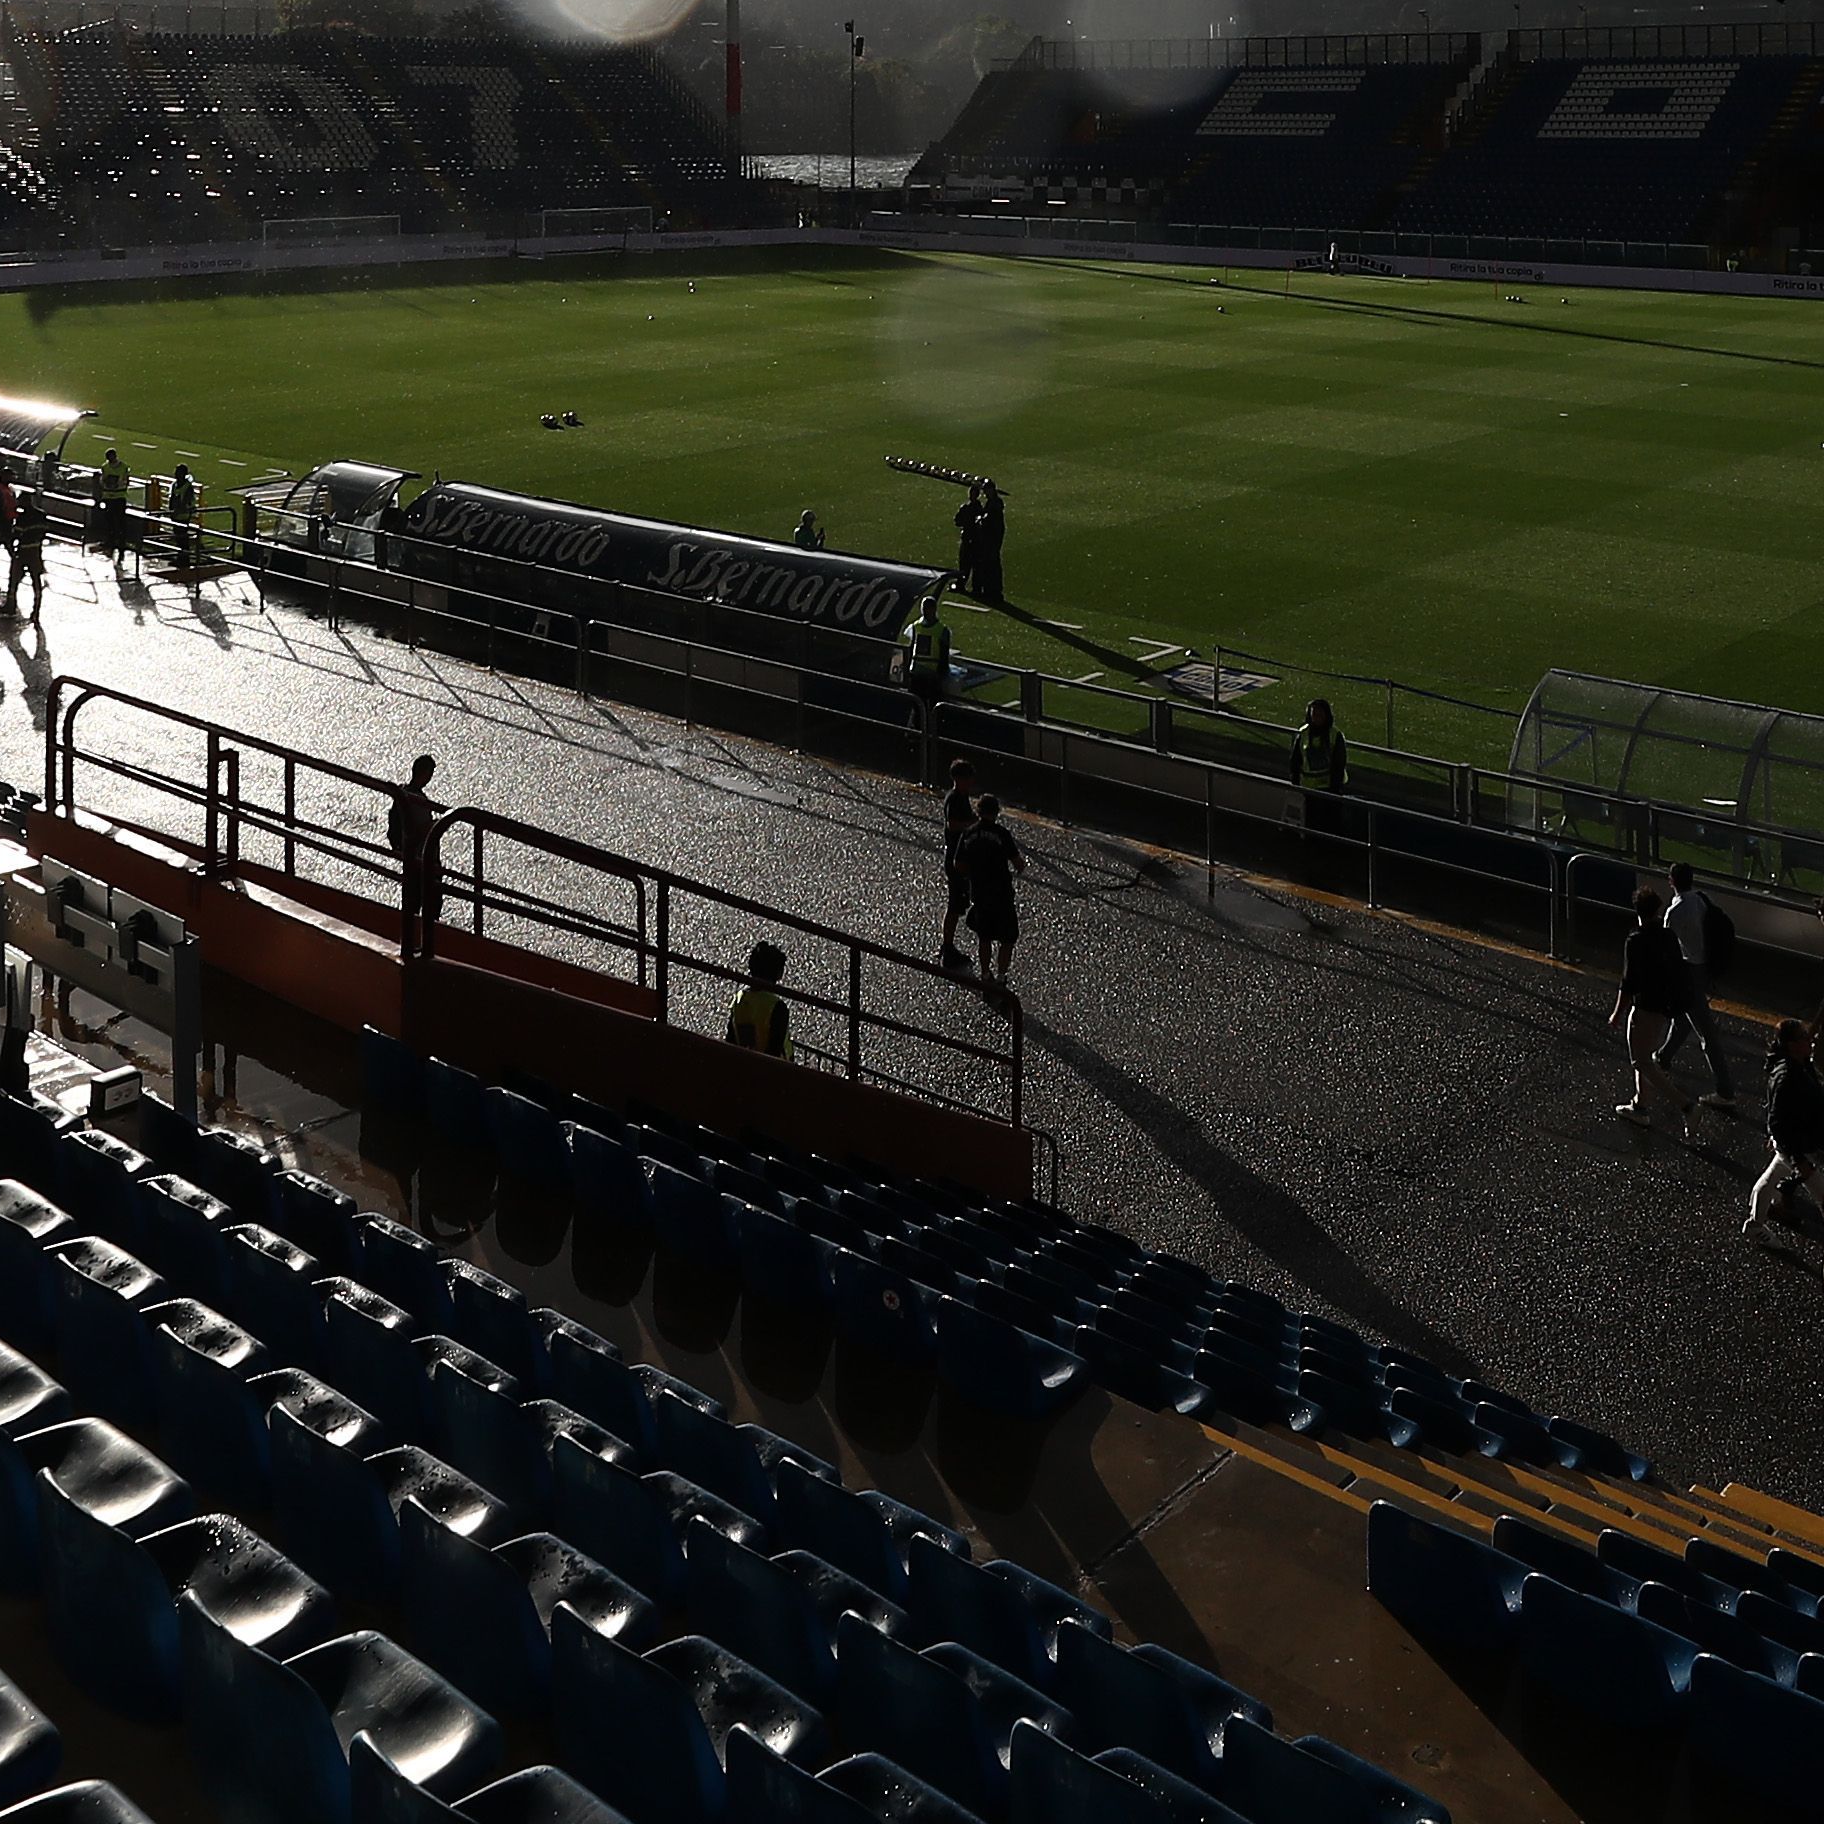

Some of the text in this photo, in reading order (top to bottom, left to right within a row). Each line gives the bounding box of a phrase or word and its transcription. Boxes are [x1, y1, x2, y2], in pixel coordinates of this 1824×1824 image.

[1450, 262, 1476, 274] Ritira
[1477, 263, 1487, 274] la
[1488, 264, 1505, 275] tua
[1506, 265, 1533, 277] copia
[1773, 279, 1805, 290] Ritira
[1806, 281, 1817, 291] la
